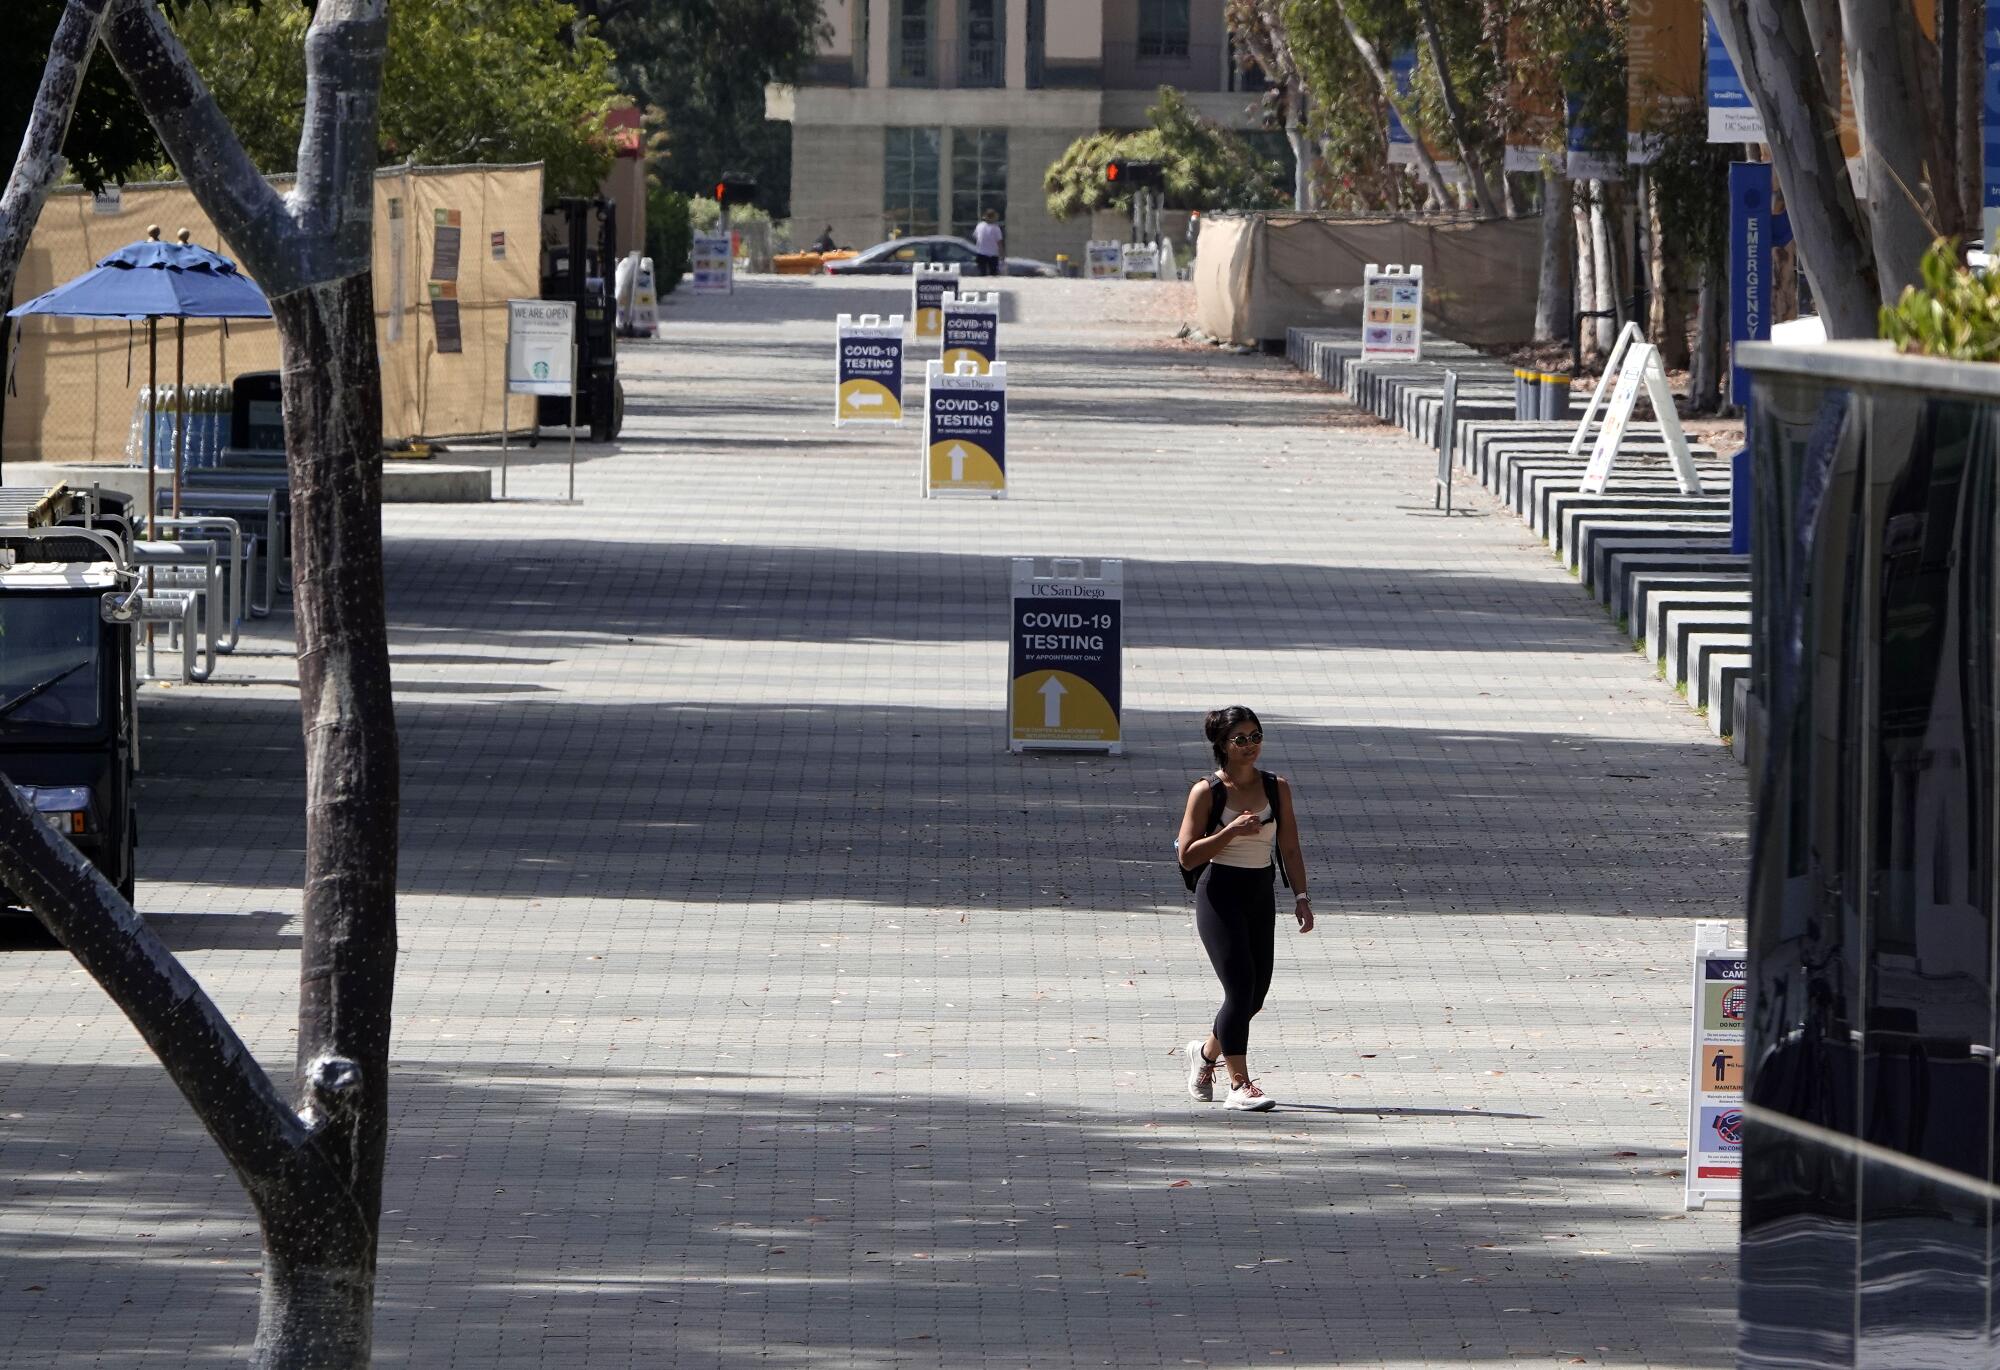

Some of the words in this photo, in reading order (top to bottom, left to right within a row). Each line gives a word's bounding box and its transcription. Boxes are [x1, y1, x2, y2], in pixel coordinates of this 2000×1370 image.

[1747, 218, 1759, 339] EMERGENCY
[514, 306, 527, 319] WE
[528, 306, 544, 319] ARE
[545, 306, 569, 319] OPEN
[947, 318, 993, 329] COVID-19
[947, 330, 989, 340] TESTING
[844, 345, 899, 357] COVID-19
[844, 358, 894, 369] TESTING
[935, 398, 1000, 412] COVID-19
[935, 414, 993, 427] TESTING
[1031, 584, 1049, 597] UC
[1050, 584, 1072, 597] San
[1074, 585, 1105, 599] Diego
[1022, 612, 1112, 629] COVID-19
[1022, 634, 1104, 650] TESTING
